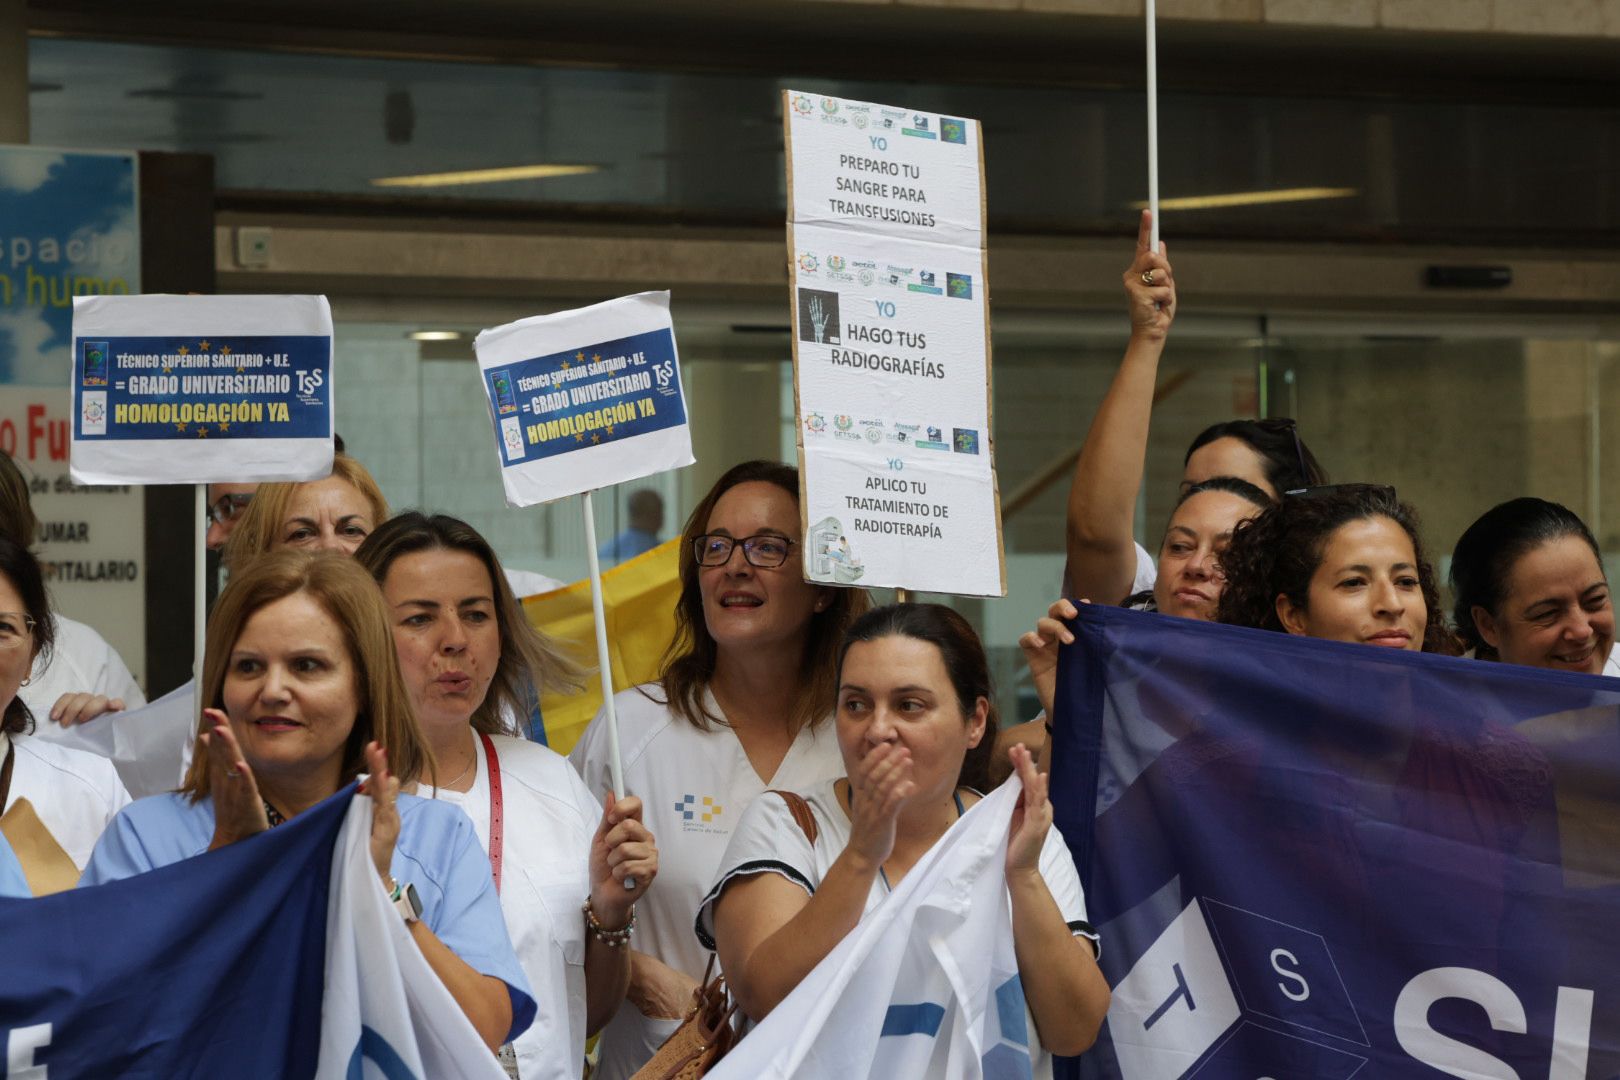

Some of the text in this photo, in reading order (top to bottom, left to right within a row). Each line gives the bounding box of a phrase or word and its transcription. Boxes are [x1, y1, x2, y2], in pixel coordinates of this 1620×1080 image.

[869, 136, 888, 151] YO
[840, 154, 920, 179] PREPARO TU
[836, 176, 926, 204] SANGRE PARA
[829, 199, 935, 228] TRANSFUSIONES
[0, 233, 127, 269] pacio
[875, 300, 896, 318] YO
[848, 324, 926, 349] HAGO TUS
[116, 353, 159, 368] TÉCNICO
[161, 354, 210, 368] SUPERIOR
[212, 354, 263, 368] SANITARIO
[274, 354, 290, 367] U.E.
[831, 349, 945, 379] RADIOGRAFÍAS
[129, 376, 178, 395] GRADO
[182, 374, 290, 394] UNIVERSITARIO
[517, 374, 550, 392] TÉCNICO
[551, 365, 588, 385] SUPERIOR
[589, 355, 626, 376] SANITARIO
[532, 390, 570, 415] GRADO
[570, 371, 651, 406] UNIVERSITARIO
[115, 400, 290, 424] HOMOLOGACIÓN YA
[527, 398, 656, 445] HOMOLOGACIÓN YA
[27, 403, 70, 461] Fu
[887, 458, 903, 471] YO
[866, 477, 927, 495] APLICO TU
[845, 496, 948, 518] TRATAMIENTO DE
[854, 518, 942, 539] RADIOTERAPÍA
[1270, 948, 1310, 1002] S
[1143, 962, 1196, 1032] T
